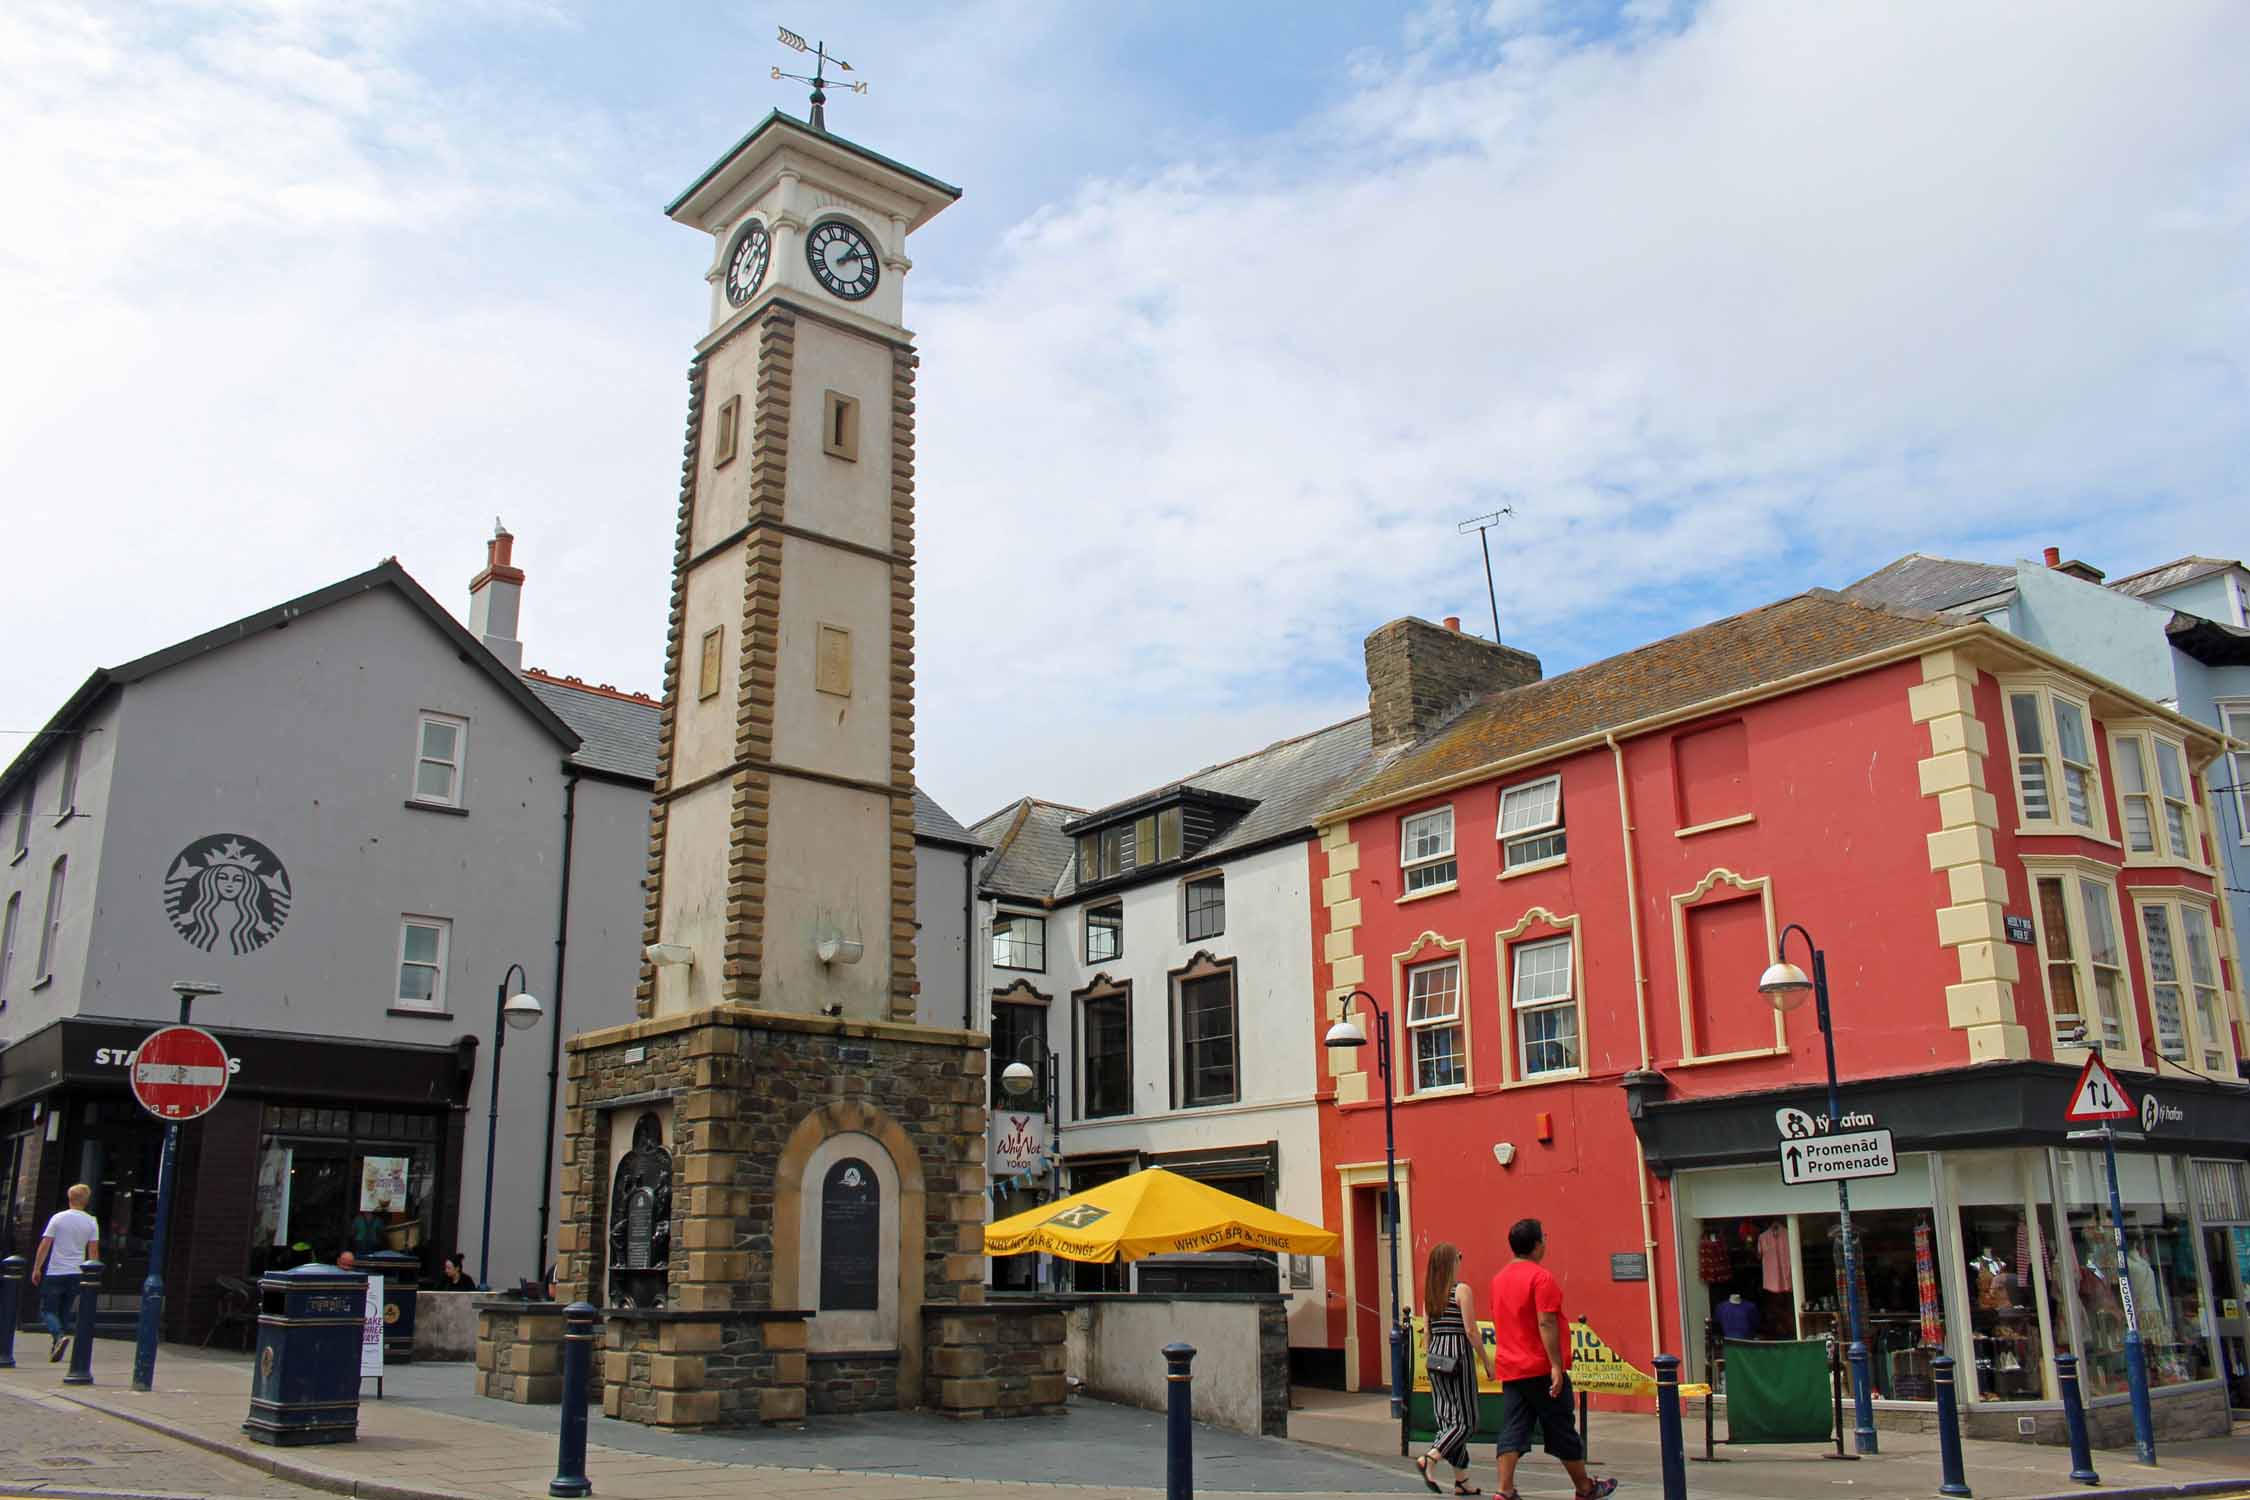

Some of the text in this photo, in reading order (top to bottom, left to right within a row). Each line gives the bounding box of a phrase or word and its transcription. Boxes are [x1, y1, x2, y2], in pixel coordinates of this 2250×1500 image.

[1840, 1111, 1875, 1128] afan
[1806, 1138, 1878, 1158] Promenâd
[1808, 1154, 1889, 1173] Promenade
[1055, 1240, 1096, 1257] LOUNGE
[1173, 1235, 1199, 1251] WHY
[1199, 1231, 1224, 1246] NOT
[363, 1334, 380, 1342] AYS
[1573, 1363, 1594, 1372] NTIL
